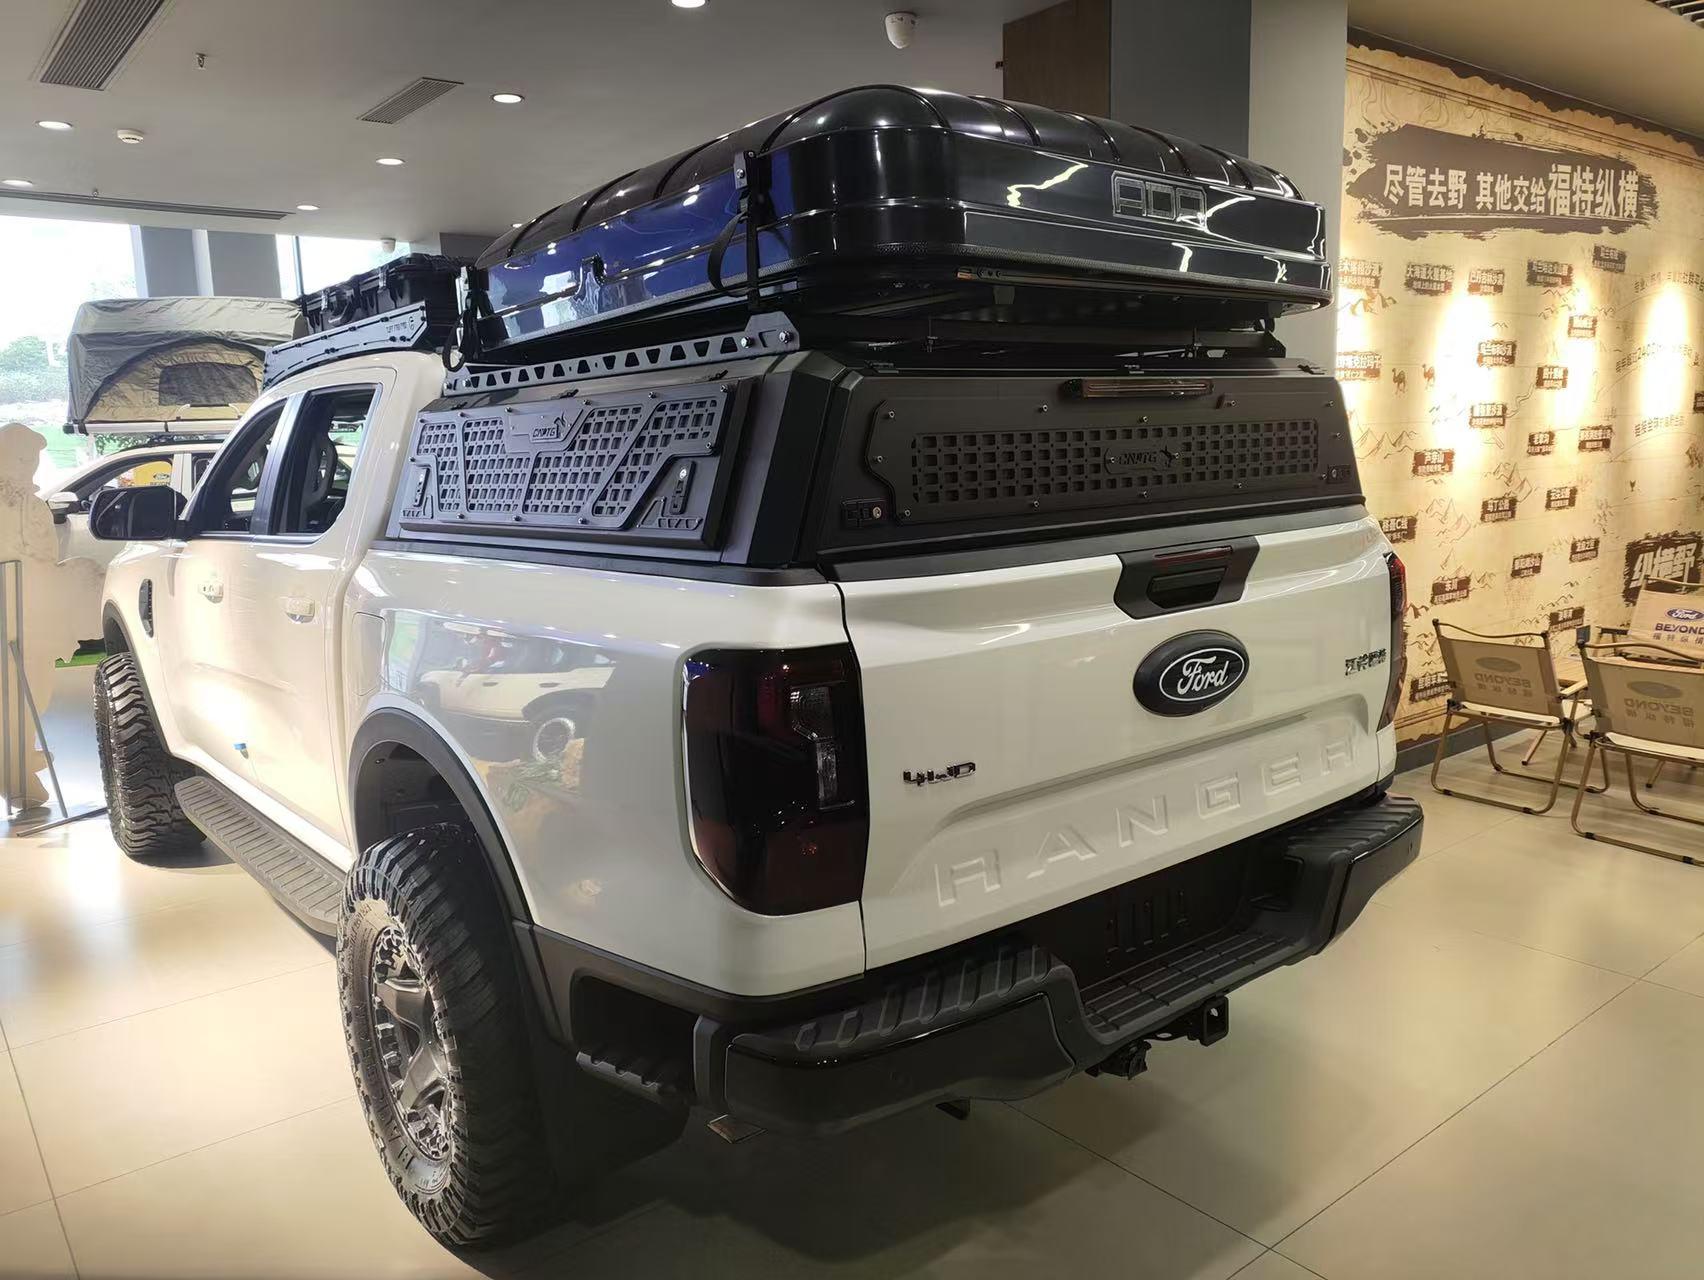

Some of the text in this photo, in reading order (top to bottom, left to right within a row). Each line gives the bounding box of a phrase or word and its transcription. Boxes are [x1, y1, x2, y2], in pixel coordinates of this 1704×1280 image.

[1384, 163, 1639, 218] 尽管去野 其他交给福特纵横
[1177, 655, 1230, 695] Ford
[903, 762, 976, 787] 4WD
[934, 738, 1358, 907] RANGER
